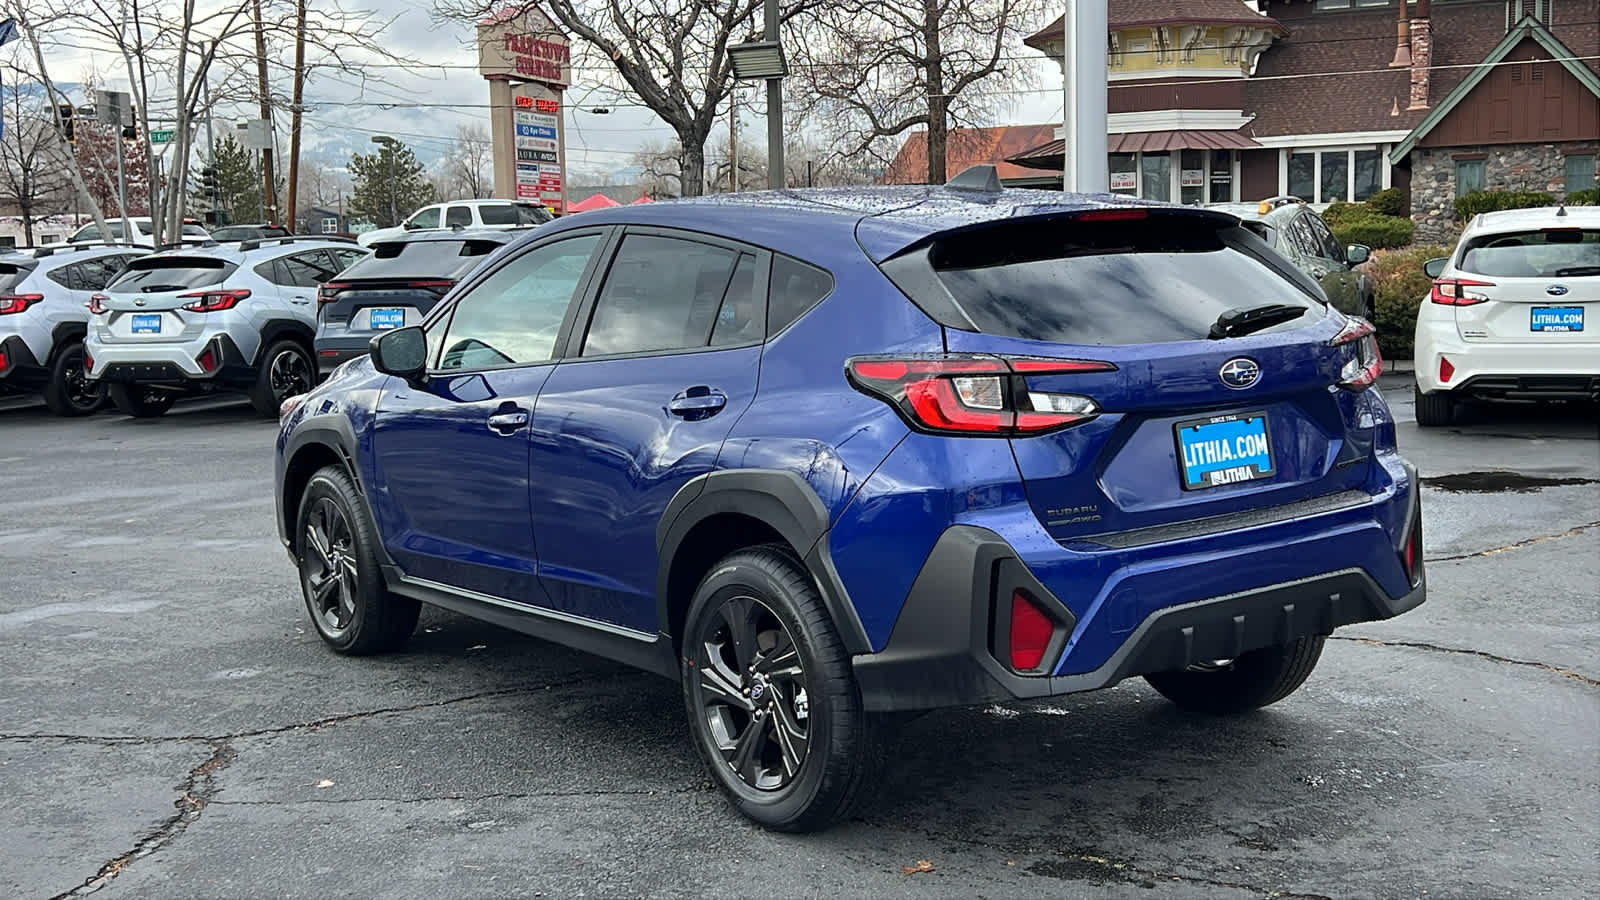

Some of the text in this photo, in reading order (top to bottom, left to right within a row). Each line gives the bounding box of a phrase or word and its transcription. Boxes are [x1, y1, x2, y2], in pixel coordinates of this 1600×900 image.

[515, 95, 559, 113] CAR WASH
[1532, 314, 1583, 324] LITHIA.COM
[1183, 432, 1269, 468] LITHIA.COM
[1047, 504, 1097, 516] SUBARU
